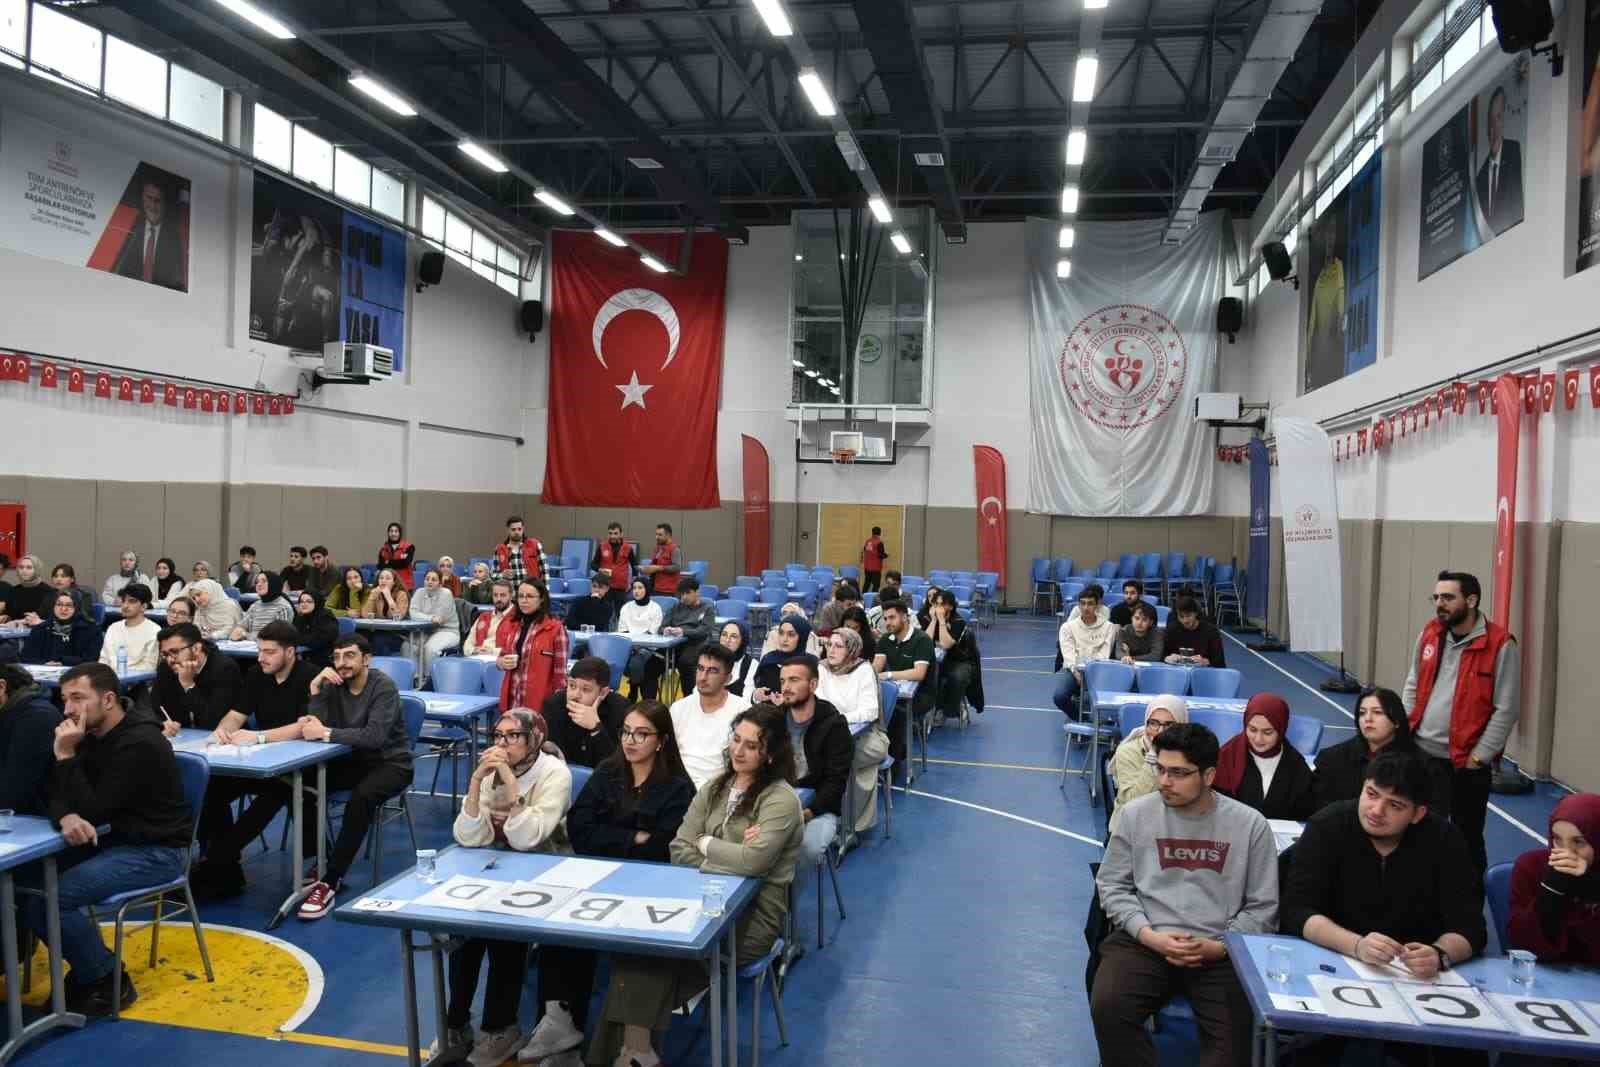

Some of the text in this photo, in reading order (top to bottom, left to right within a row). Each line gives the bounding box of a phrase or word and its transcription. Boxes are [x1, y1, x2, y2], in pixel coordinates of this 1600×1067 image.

[445, 884, 489, 900] D
[501, 890, 553, 909] C
[569, 898, 625, 921] B
[645, 905, 689, 925] A
[1332, 986, 1383, 1009] D
[1415, 993, 1481, 1019] C
[1515, 1001, 1591, 1036] B
